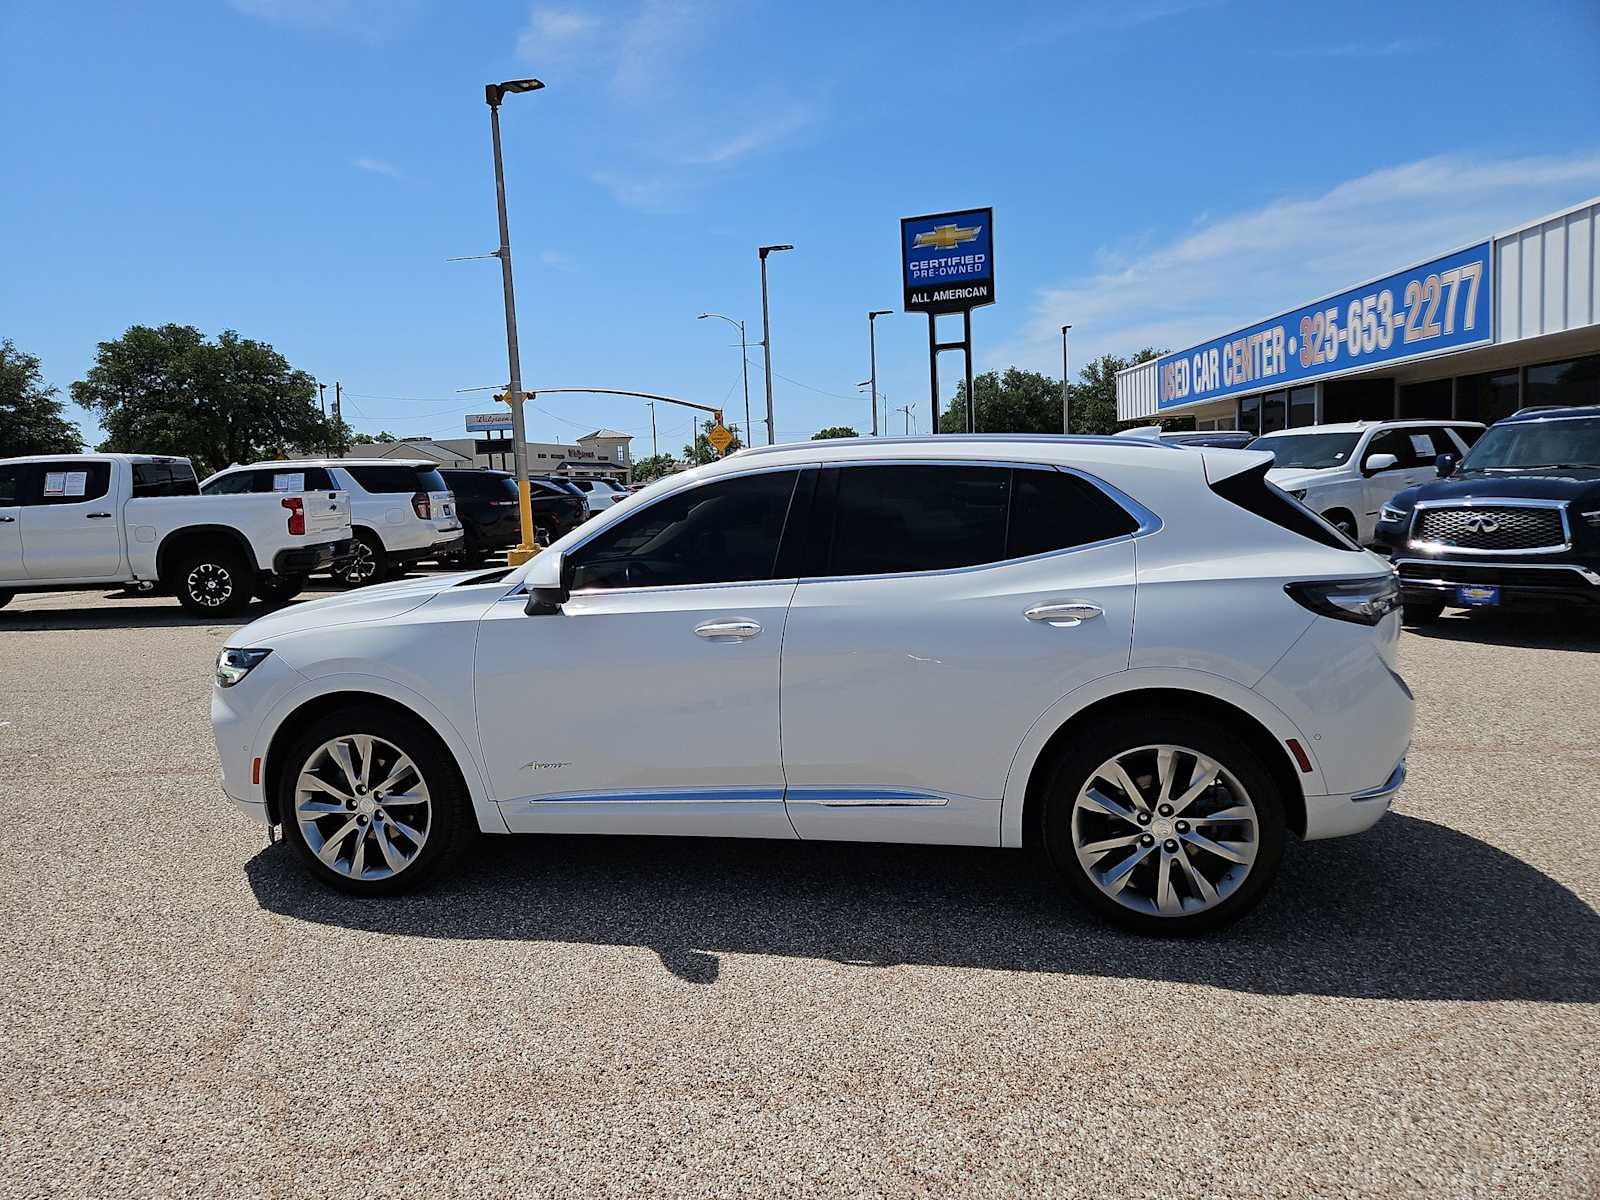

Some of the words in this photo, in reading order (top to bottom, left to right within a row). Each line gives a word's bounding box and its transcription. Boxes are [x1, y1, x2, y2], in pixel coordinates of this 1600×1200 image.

[909, 254, 986, 271] CERTIFIED
[913, 263, 982, 279] PRE-OWNED
[911, 293, 930, 304] ALL
[933, 286, 987, 302] AMERICAN
[1160, 357, 1191, 403] USED
[1192, 346, 1220, 395] CAR
[1222, 325, 1286, 386] CENTER
[1299, 260, 1483, 369] 325-653-2277
